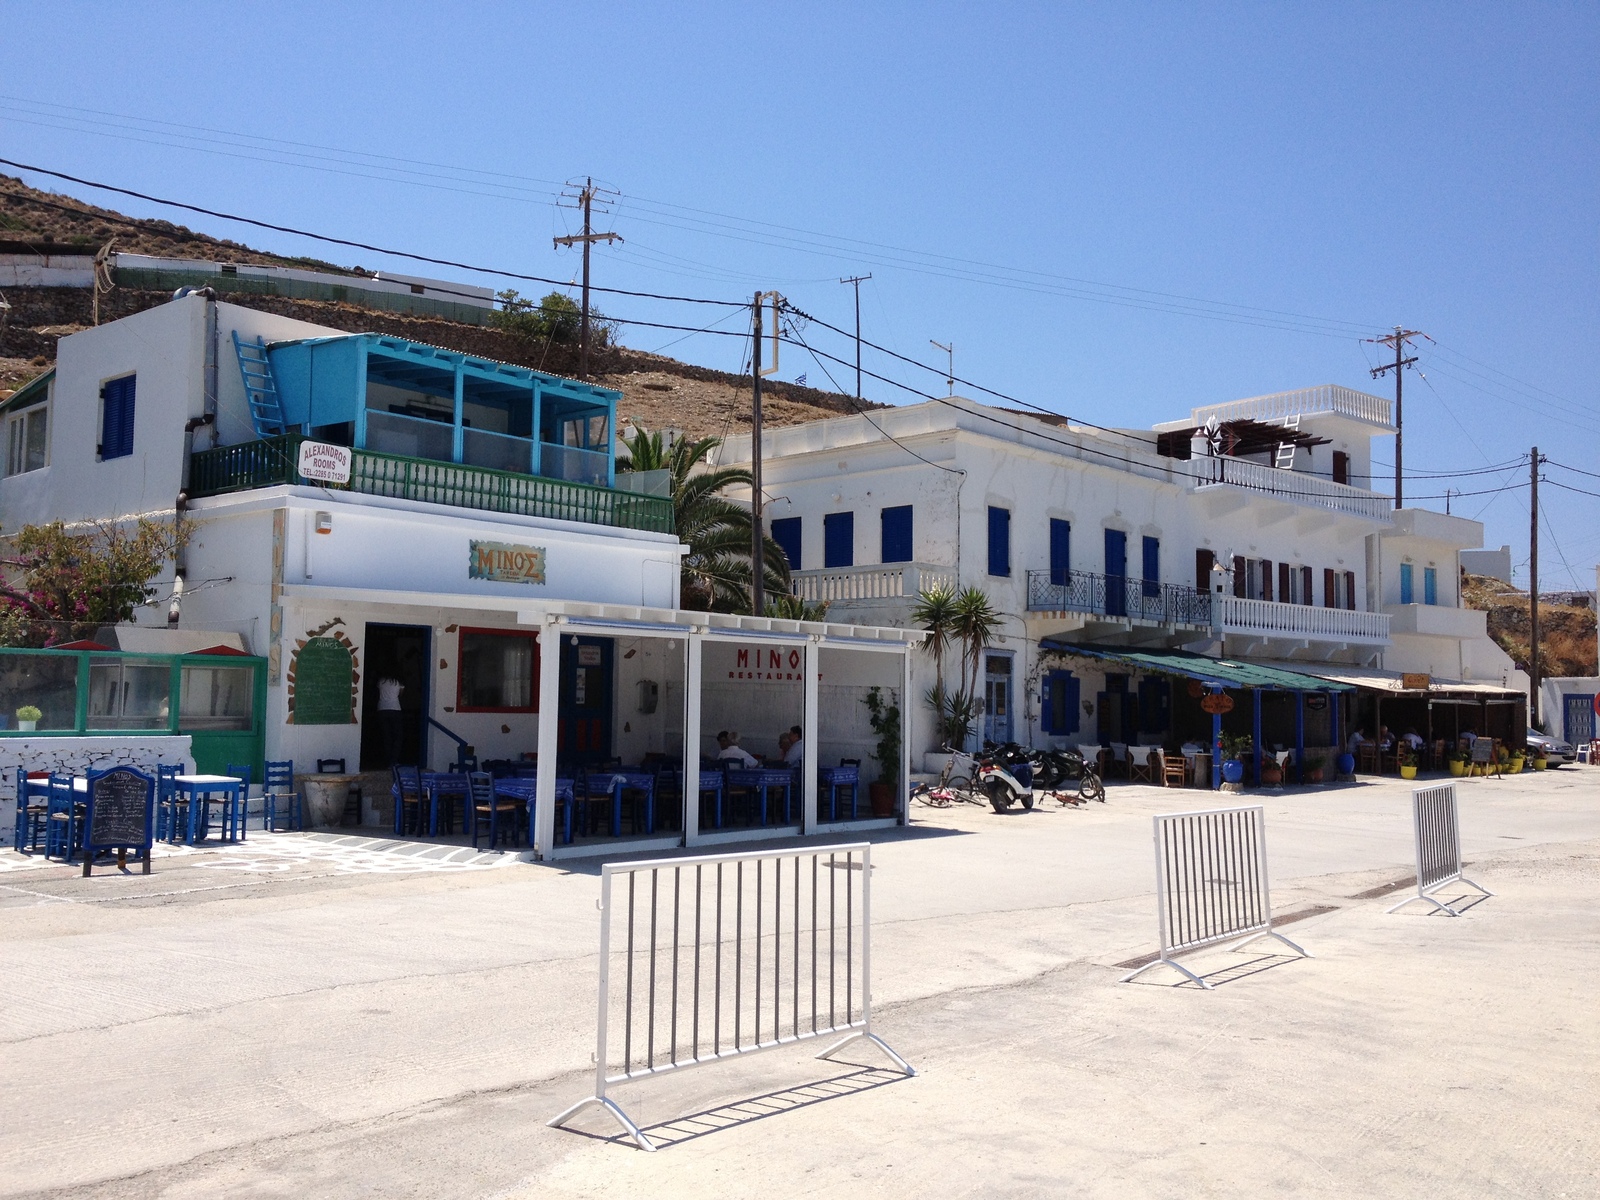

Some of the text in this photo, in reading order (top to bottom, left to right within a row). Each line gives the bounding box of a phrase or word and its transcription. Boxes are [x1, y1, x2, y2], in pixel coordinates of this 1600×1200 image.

[304, 444, 347, 466] ALEXANDROS
[313, 458, 336, 470] ROOMS
[737, 649, 800, 669] MINO
[729, 672, 823, 681] RESTAURAT
